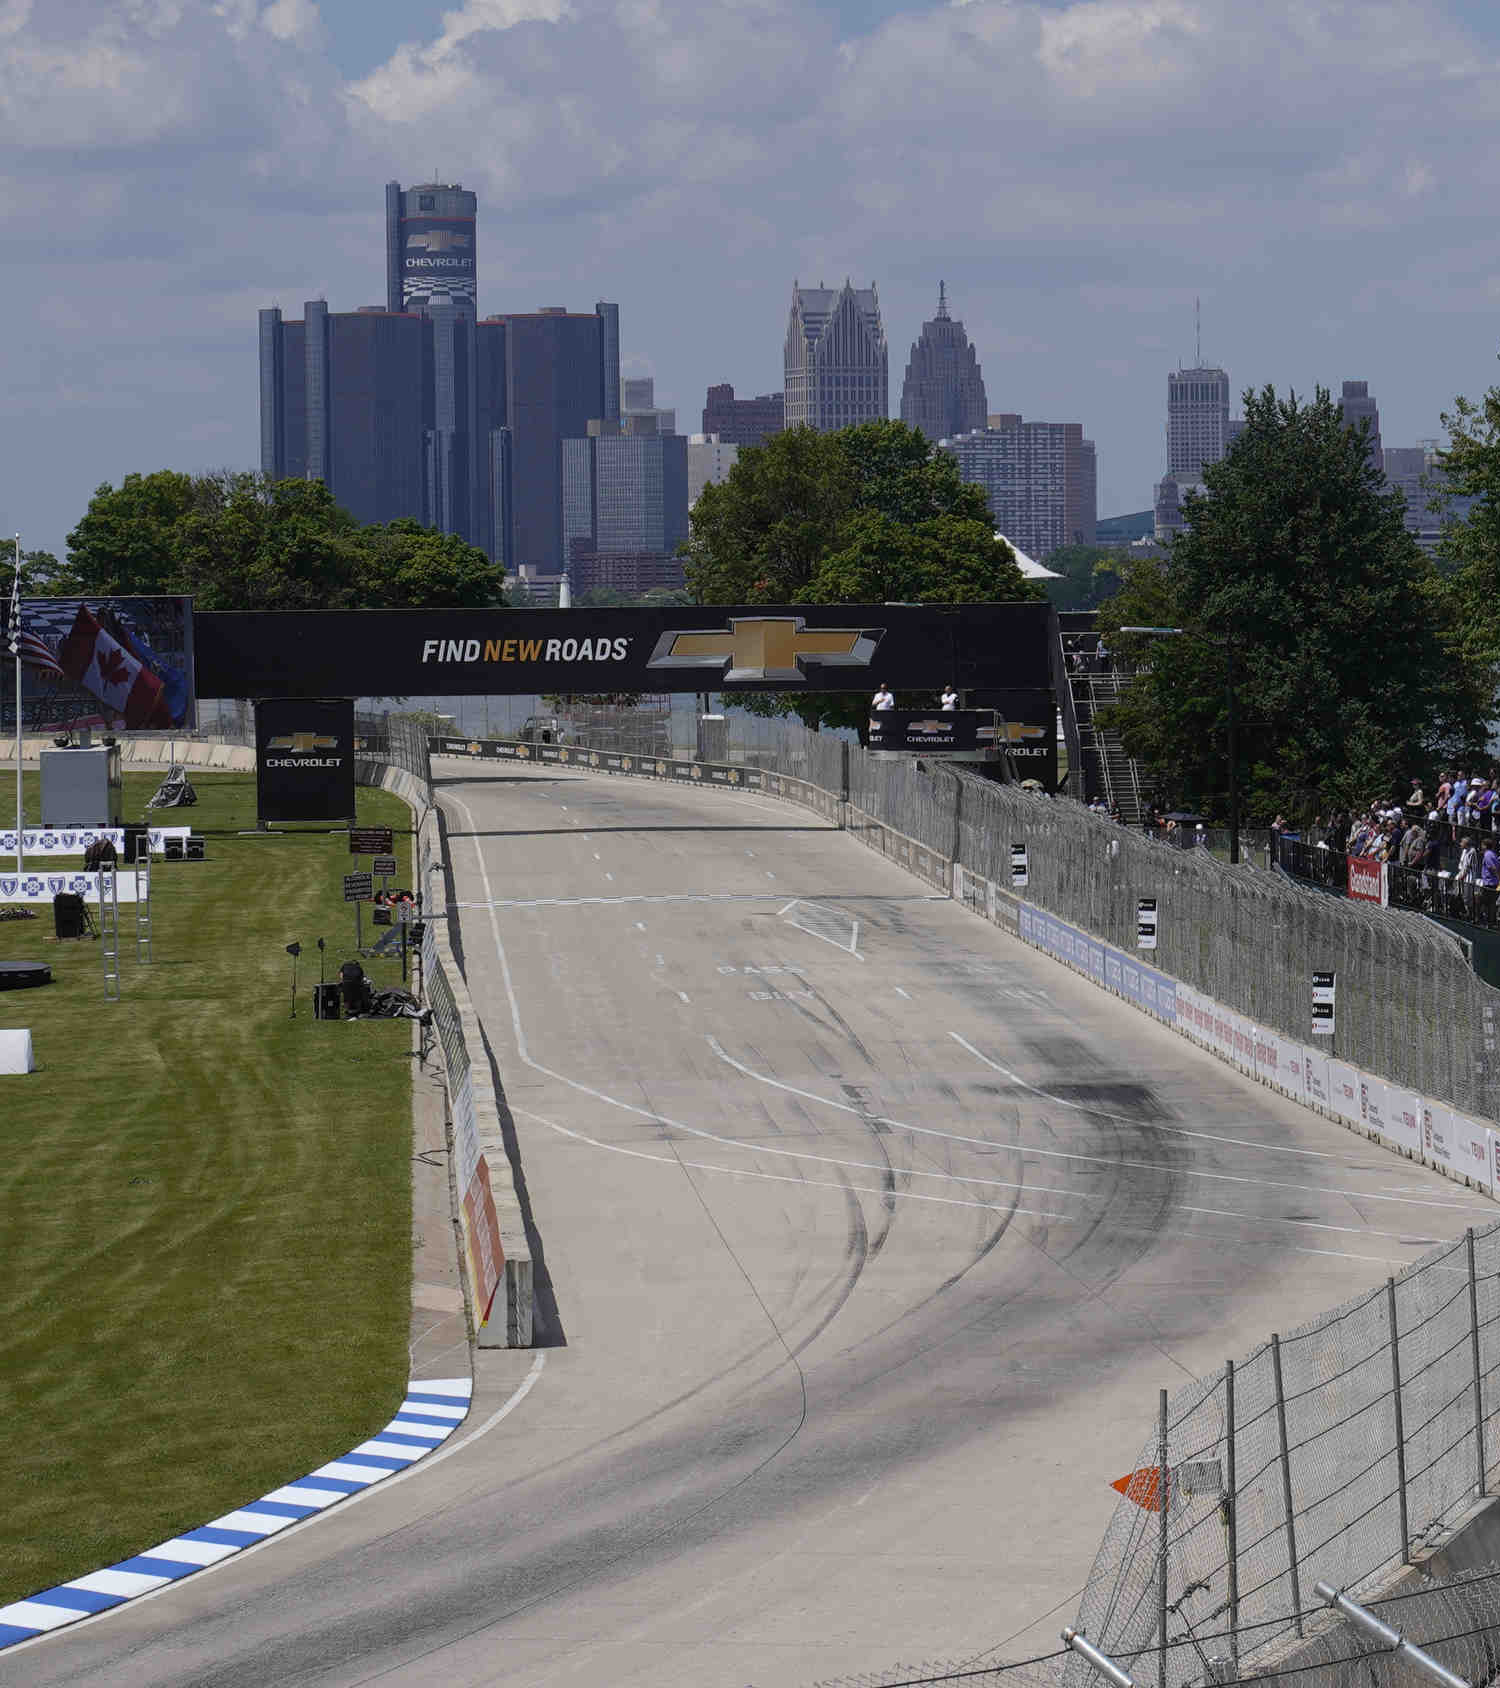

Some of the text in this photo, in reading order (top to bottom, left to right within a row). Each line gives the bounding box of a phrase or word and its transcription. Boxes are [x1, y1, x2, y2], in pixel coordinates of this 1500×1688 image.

[406, 257, 473, 267] CHEVROLET
[422, 638, 628, 663] FIND NEW ROADS
[266, 758, 342, 767] CHEVROLET
